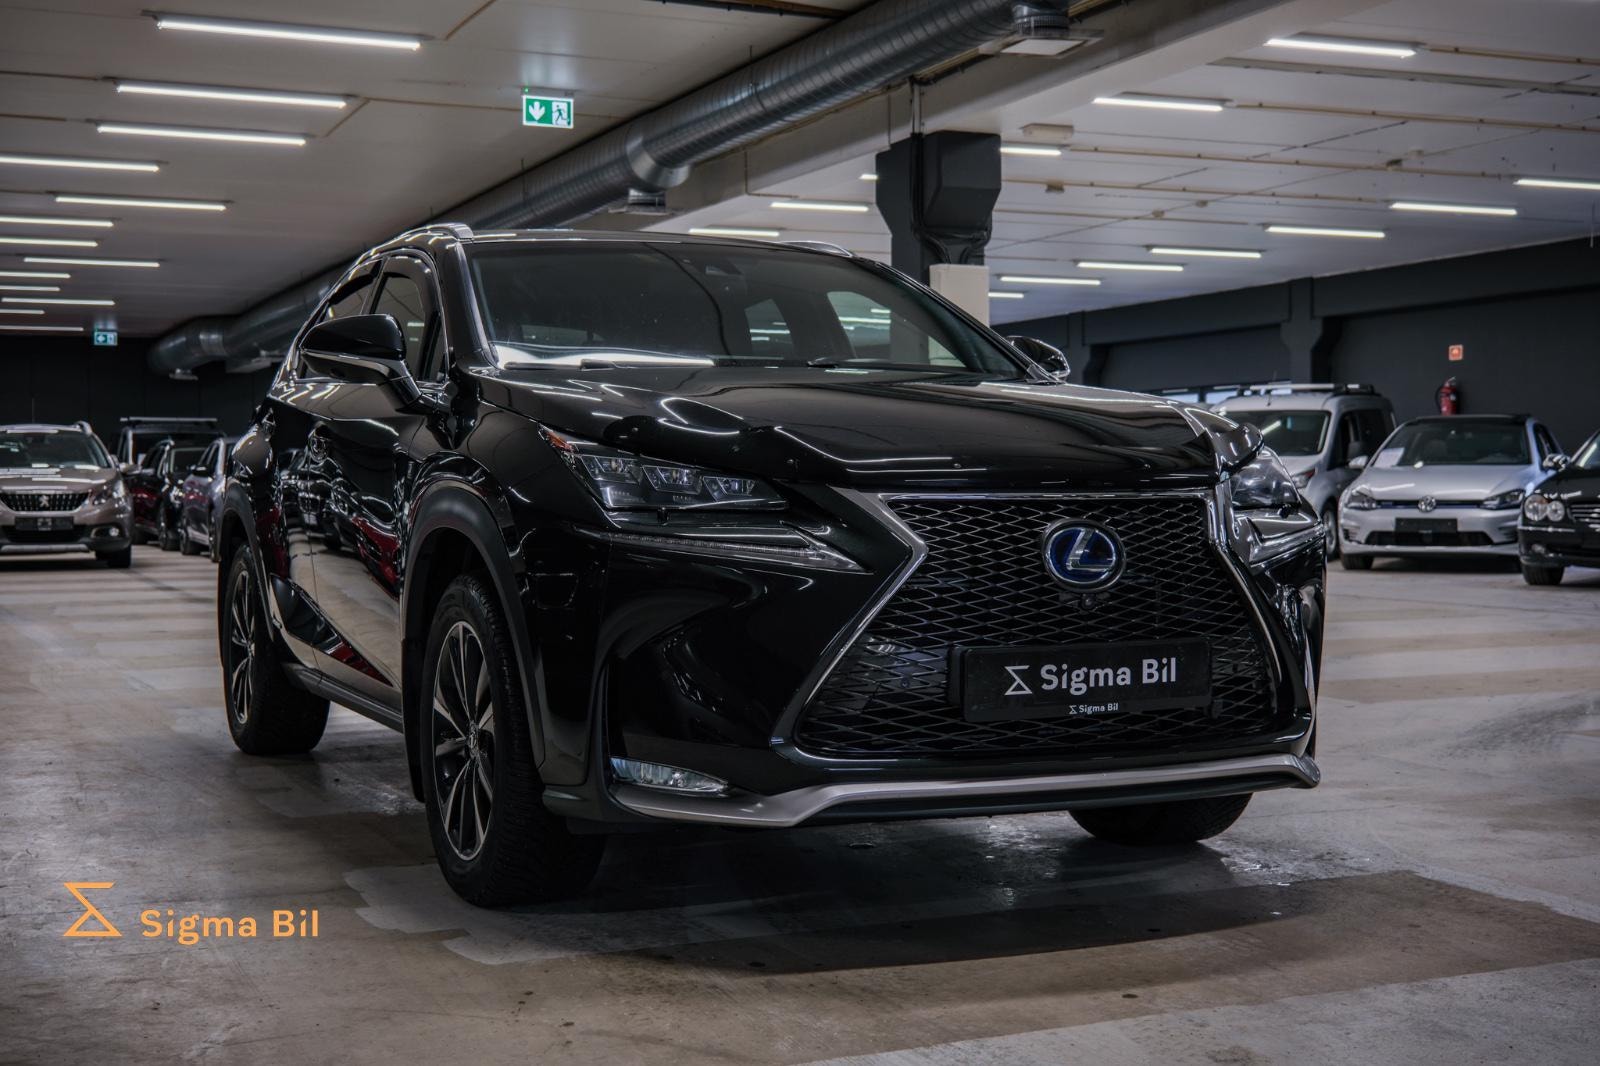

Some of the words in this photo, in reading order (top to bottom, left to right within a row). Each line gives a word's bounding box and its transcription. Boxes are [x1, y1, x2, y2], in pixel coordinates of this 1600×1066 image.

[1040, 663, 1131, 696] Sigma
[1142, 657, 1177, 684] Bil
[1078, 704, 1106, 715] Sigma
[1107, 702, 1119, 712] Bil
